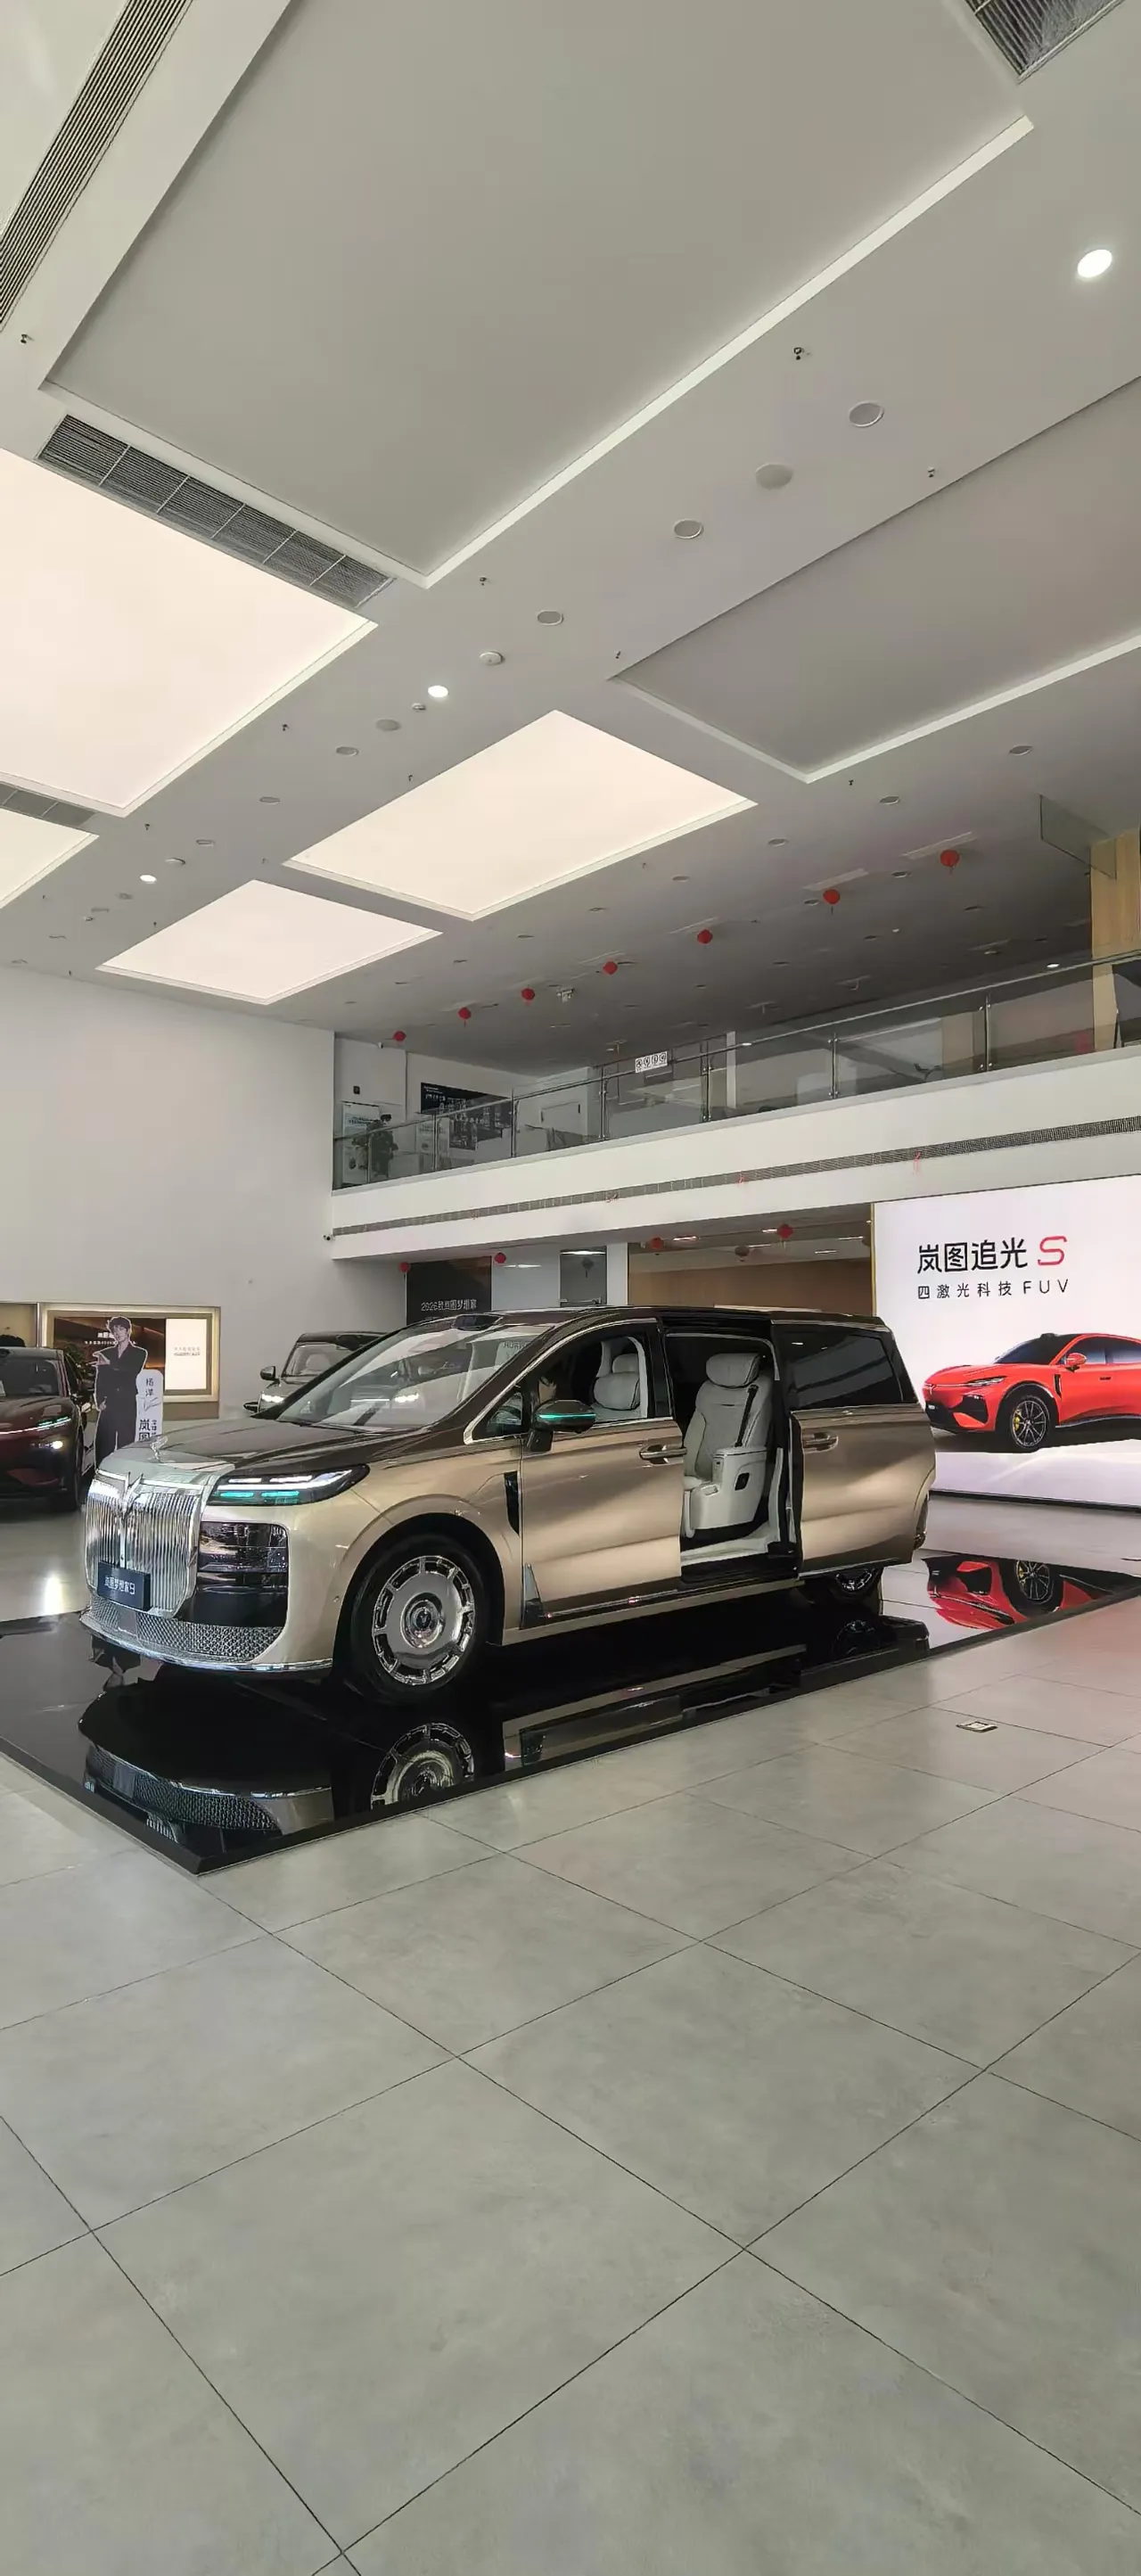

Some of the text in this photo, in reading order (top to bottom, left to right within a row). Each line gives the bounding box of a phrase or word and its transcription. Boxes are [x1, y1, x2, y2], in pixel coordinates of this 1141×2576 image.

[917, 1236, 1067, 1273] 岚图追光 S
[917, 1279, 1069, 1299] 四激光科技 FUV
